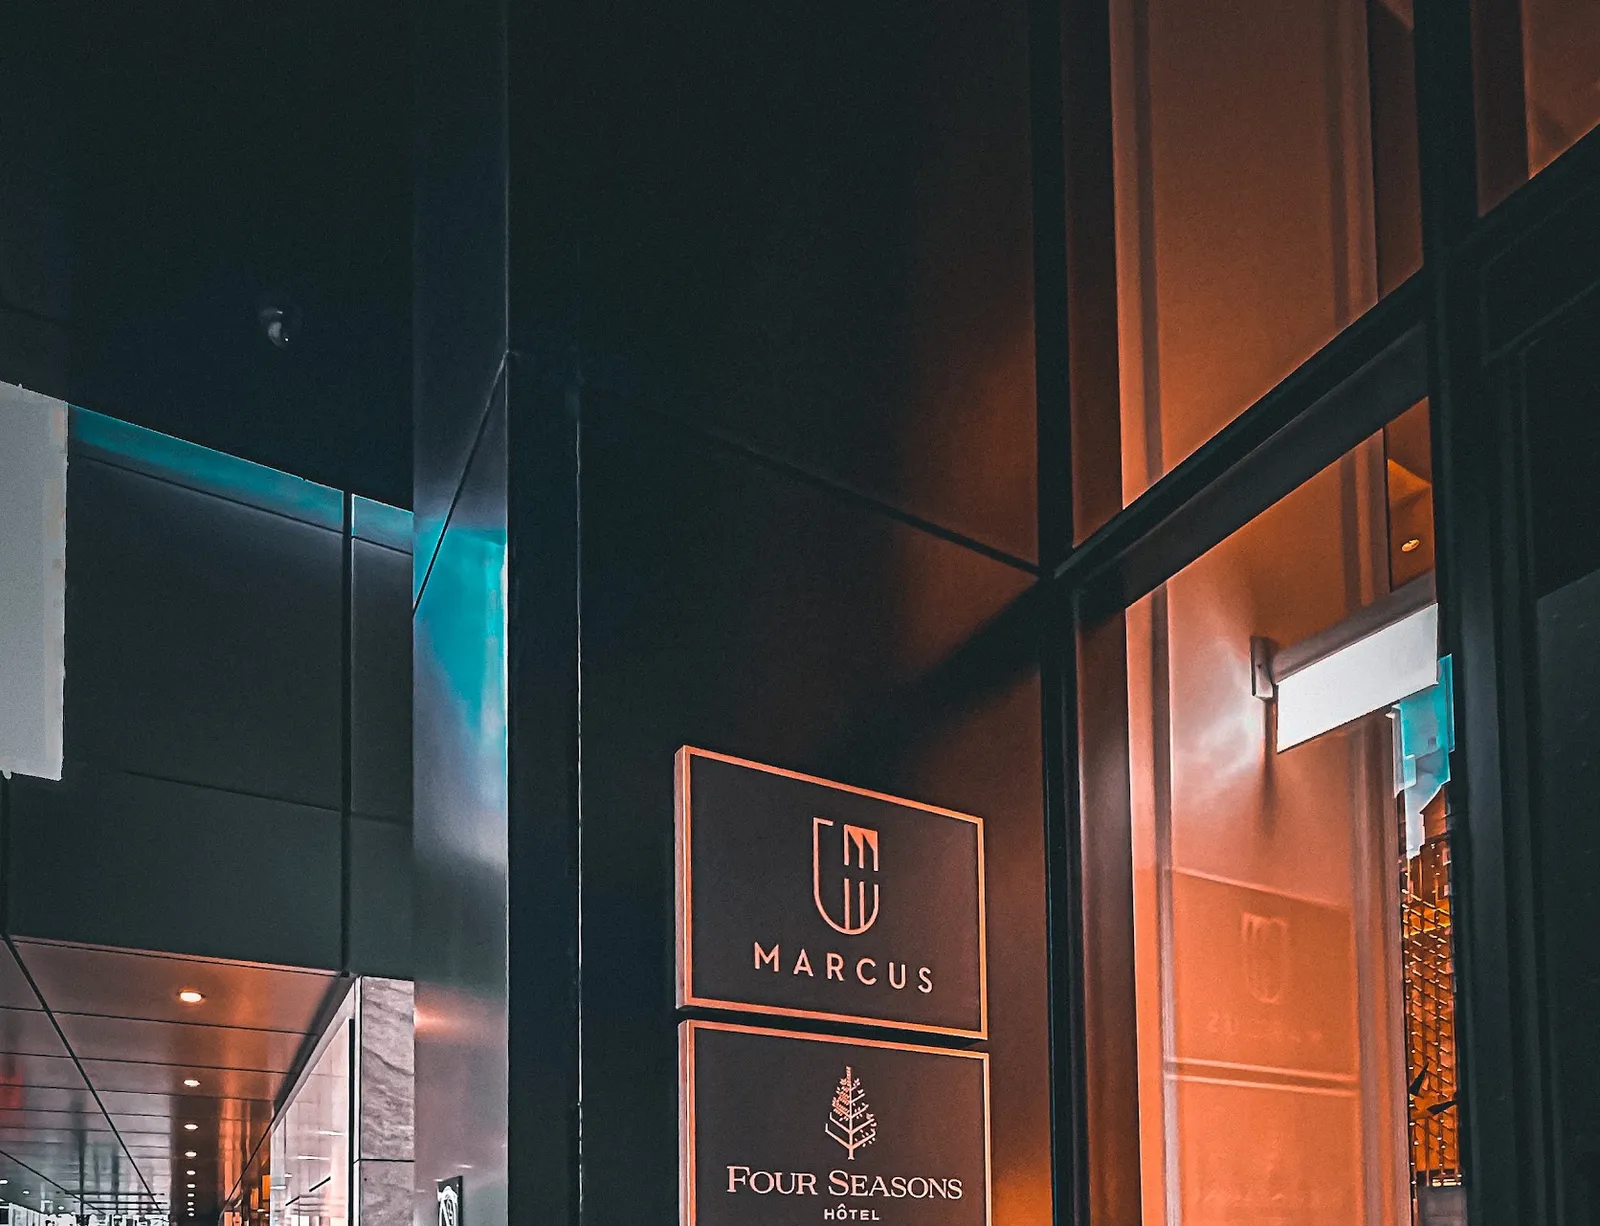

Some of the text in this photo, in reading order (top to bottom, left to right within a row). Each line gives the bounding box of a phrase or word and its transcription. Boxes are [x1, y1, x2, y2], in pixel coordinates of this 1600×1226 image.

[753, 940, 934, 994] MARCUS
[726, 1165, 964, 1200] FOUR SEASONS
[823, 1203, 881, 1221] HÔTEL
